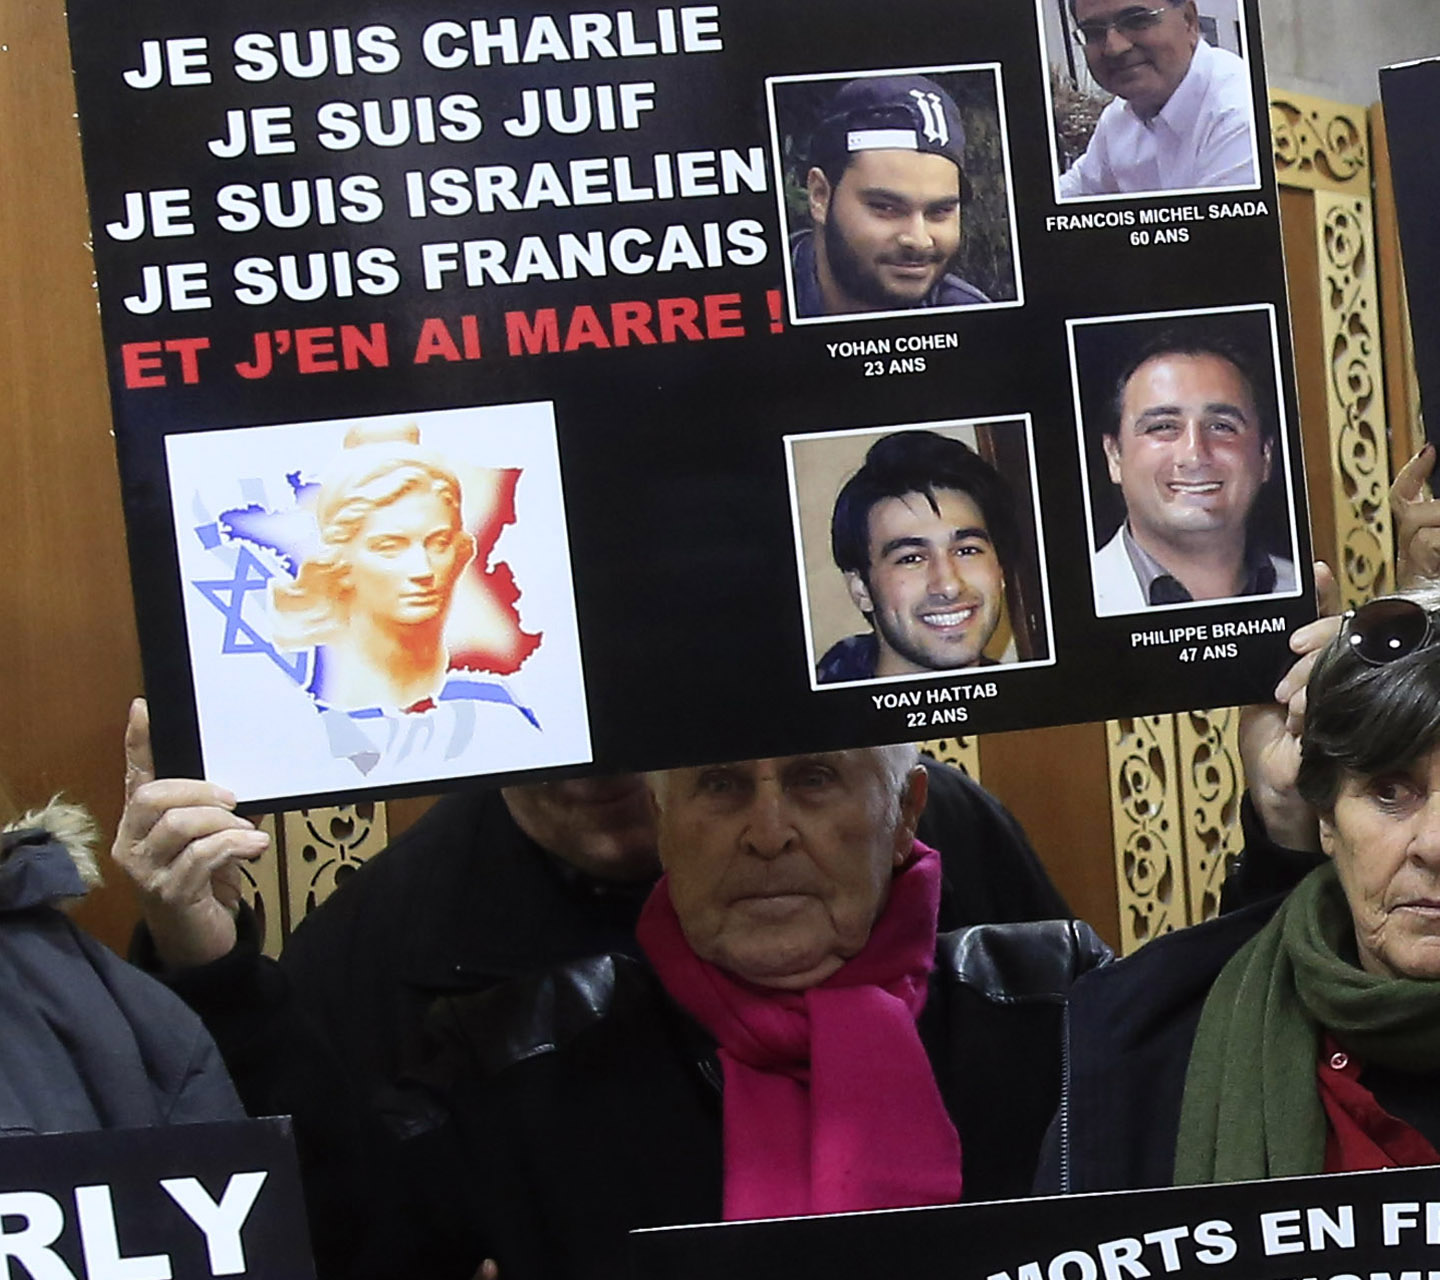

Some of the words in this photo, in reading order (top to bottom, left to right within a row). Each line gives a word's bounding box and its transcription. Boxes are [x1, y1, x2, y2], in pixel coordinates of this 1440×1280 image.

[124, 38, 211, 88] JE
[234, 26, 400, 80] SUIS
[424, 6, 722, 68] CHARLIE
[208, 108, 295, 157] JE
[318, 95, 481, 149] SUIS
[504, 82, 654, 136] JUIF
[106, 190, 194, 240] JE
[218, 176, 382, 231] SUIS
[406, 148, 766, 217] ISRAELIEN
[1046, 211, 1135, 231] FRANCOIS
[1140, 206, 1204, 223] MICHEL
[1209, 202, 1268, 218] SAADA
[1131, 231, 1149, 245] 60
[1154, 228, 1189, 244] ANS
[124, 263, 211, 314] JE
[234, 248, 399, 304] SUIS
[422, 220, 766, 289] FRANCAIS
[122, 338, 210, 388] ET
[414, 315, 480, 364] AI
[505, 294, 745, 356] MARRE
[827, 339, 890, 357] YOHAN
[896, 334, 958, 351] COHEN
[865, 361, 884, 376] 23
[889, 358, 926, 374] ANS
[1132, 626, 1208, 646] PHILIPPE
[1212, 618, 1285, 638] BRAHAM
[1180, 648, 1197, 662] 47
[1203, 644, 1237, 660] ANS
[872, 692, 921, 709] YOAV
[927, 683, 997, 703] HATTAB
[907, 712, 926, 727] 22
[932, 708, 967, 724] ANS
[1260, 1206, 1354, 1255] EN
